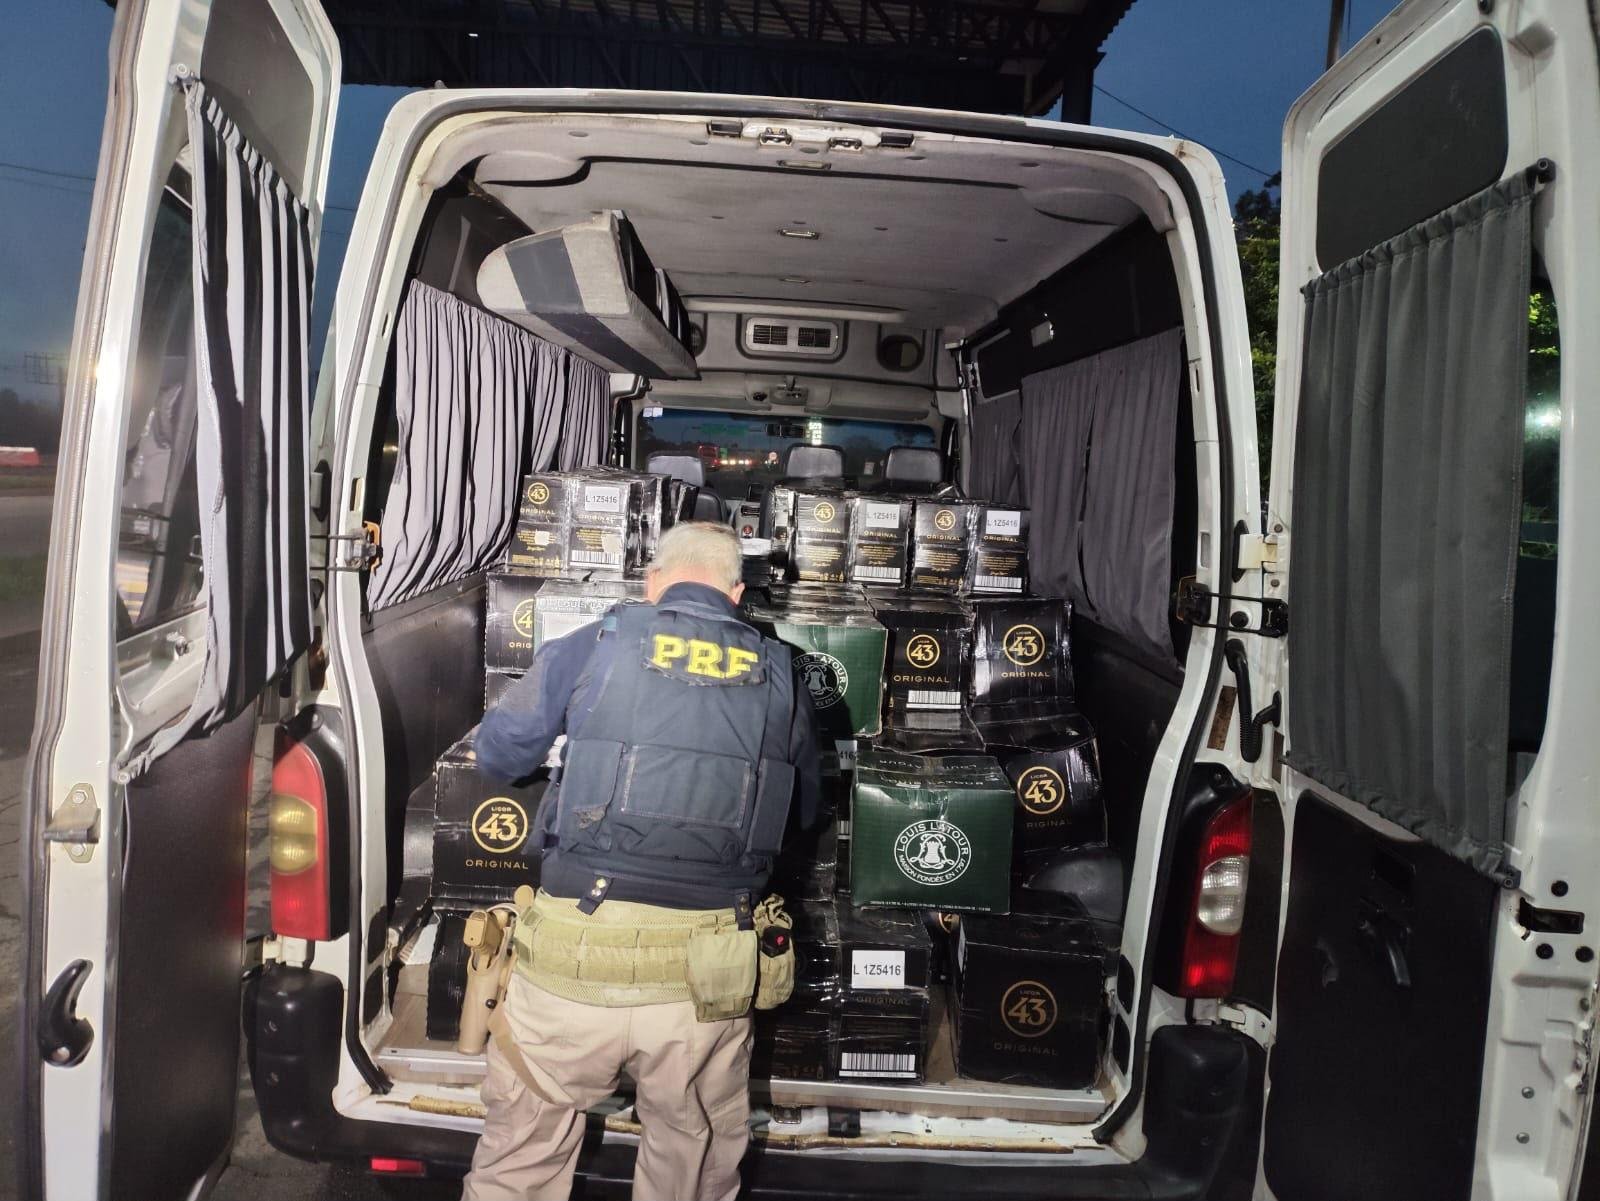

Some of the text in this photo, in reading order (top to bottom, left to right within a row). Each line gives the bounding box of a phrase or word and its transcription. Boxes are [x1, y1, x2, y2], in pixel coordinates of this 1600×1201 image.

[530, 488, 546, 500] 43
[592, 496, 617, 504] 1Z5416
[520, 507, 555, 515] ORIGINAL
[816, 507, 832, 519] 43
[937, 515, 952, 527] 43
[863, 529, 898, 539] ORIGINAL
[983, 535, 1019, 543] ORIGINAL
[517, 610, 533, 629] 4
[508, 641, 532, 649] ORIG
[1008, 636, 1038, 657] 43
[652, 633, 758, 679] PRF
[910, 644, 934, 661] 43
[813, 654, 846, 684] LATOUR
[893, 674, 950, 683] ORIGINAL
[1024, 779, 1057, 803] 43
[478, 813, 518, 841] 43
[1026, 819, 1073, 829] RIGINAL
[897, 821, 969, 855] LOUIS LATOUR
[465, 859, 529, 869] ORIGINAL
[899, 855, 917, 878] MAISON
[853, 964, 901, 976] L 1Z5416
[1007, 997, 1047, 1026] 43
[993, 1042, 1058, 1056] ORIGINAL
